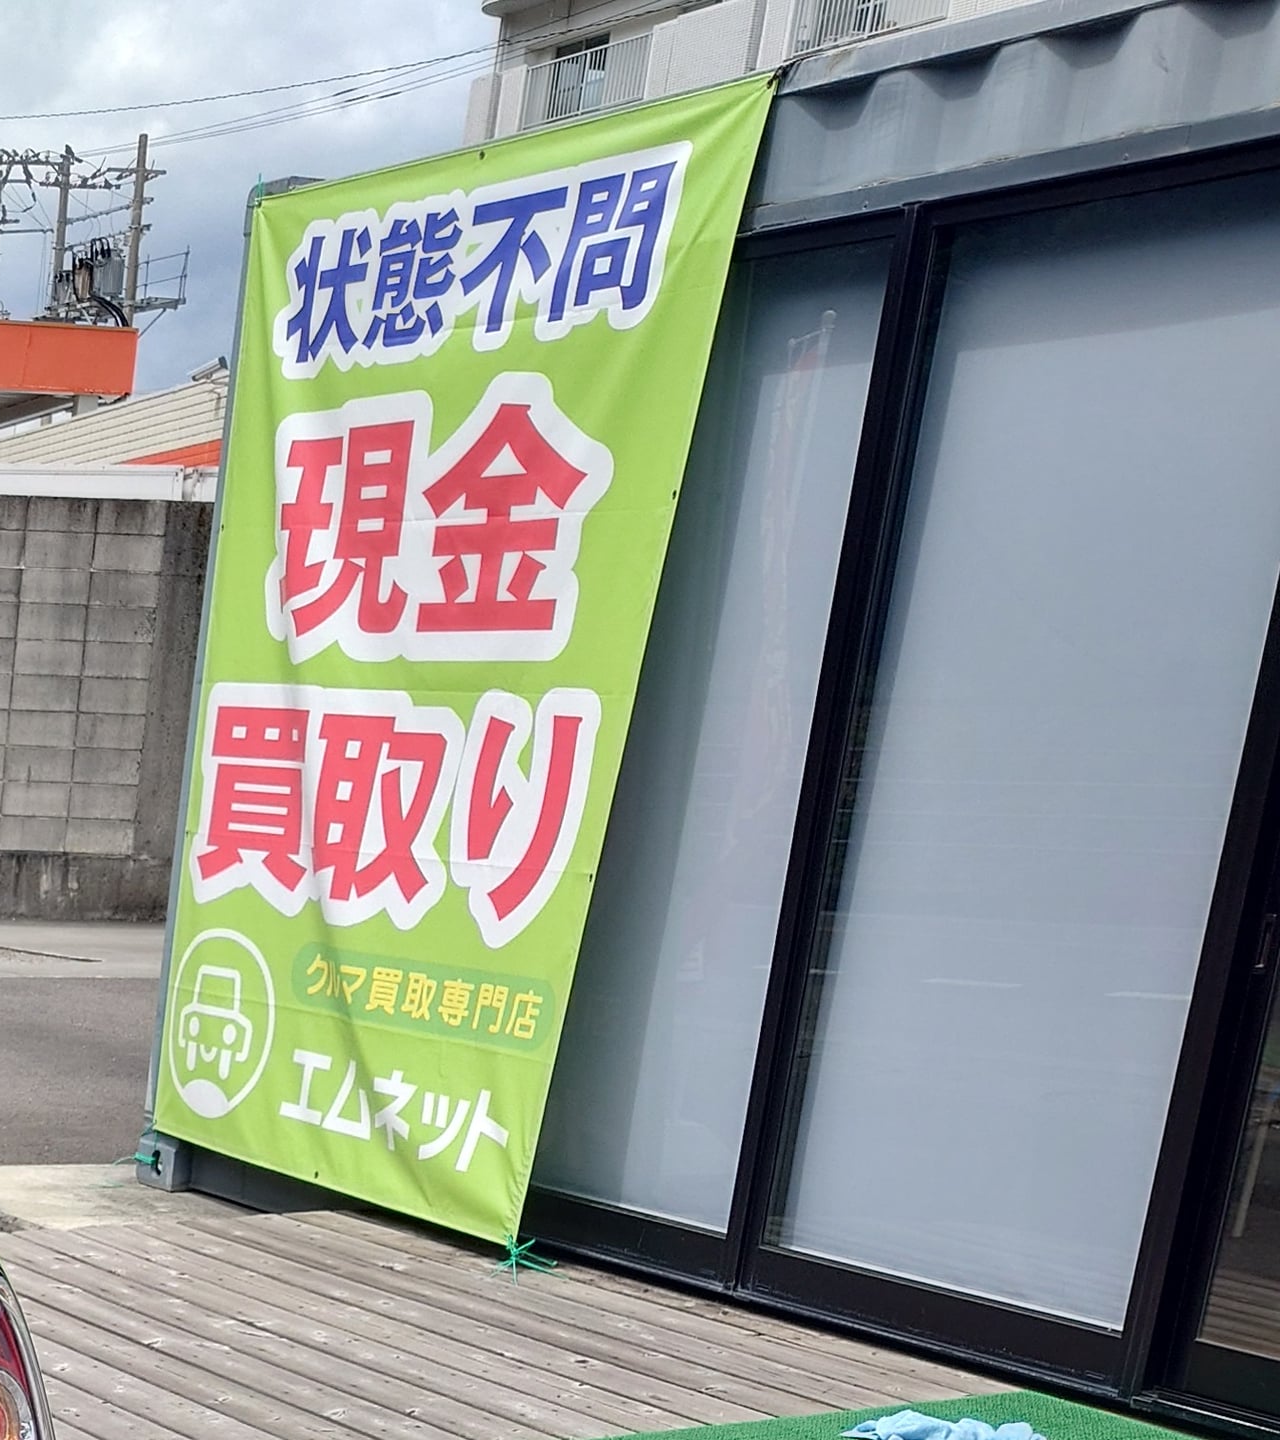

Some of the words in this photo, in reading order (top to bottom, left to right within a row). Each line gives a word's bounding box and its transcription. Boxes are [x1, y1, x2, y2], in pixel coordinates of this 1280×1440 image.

[286, 160, 679, 364] 状態不問
[280, 402, 589, 639] 現金
[196, 704, 583, 922] 買取り
[306, 952, 544, 1040] クルマ買取専門店
[278, 1048, 511, 1173] エムネット
